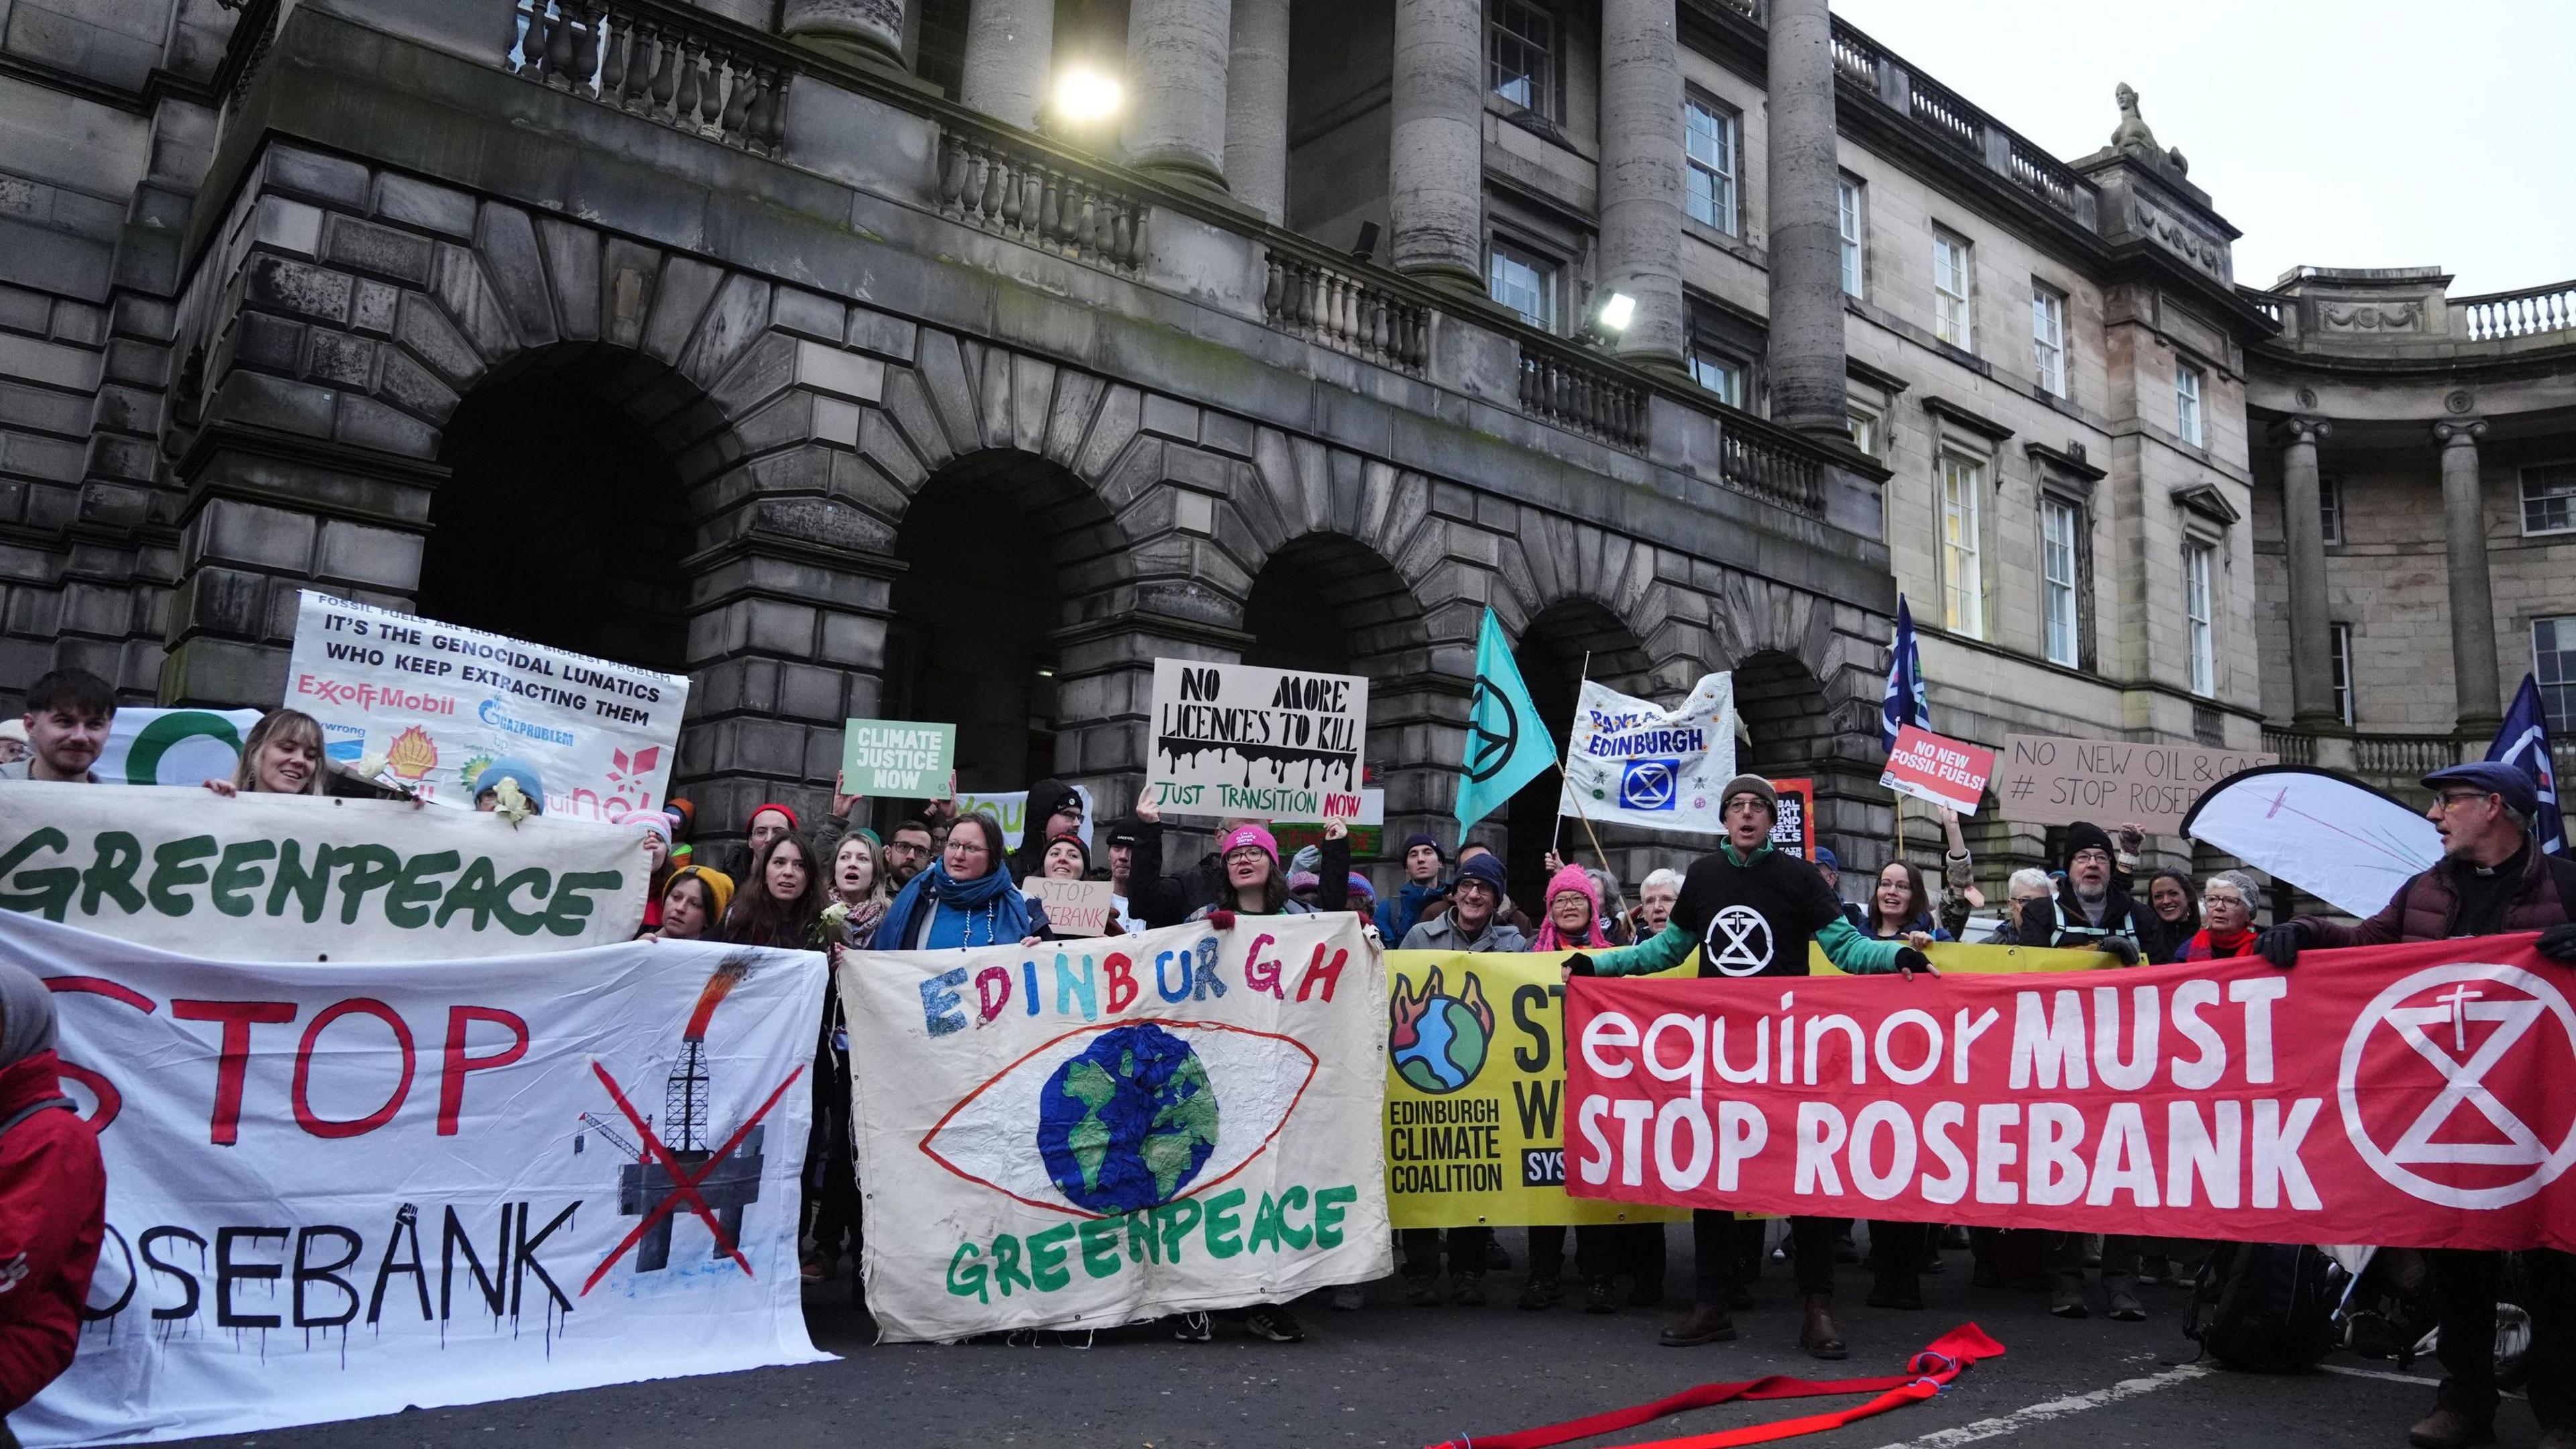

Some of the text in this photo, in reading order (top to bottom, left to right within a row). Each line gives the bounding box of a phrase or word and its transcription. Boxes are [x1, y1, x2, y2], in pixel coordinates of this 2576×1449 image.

[318, 595, 373, 613] FOSSIL
[381, 609, 427, 624] FUELS
[608, 659, 671, 683] PROBLEM
[325, 614, 660, 703] IT'S THE GENOCIDAL LUNATICS
[326, 641, 649, 727] WHO KEEP EXTRACTING THEM
[1181, 667, 1350, 712] NO MORE
[857, 727, 943, 751] CLIMATE
[1163, 703, 1357, 751] LICENCES TO KILL
[1588, 729, 1703, 757] EDINBURGH
[857, 747, 938, 771] JUSTICE
[1890, 749, 1936, 775] FOSSIL
[1937, 765, 1986, 791] FUELS!
[1914, 741, 1970, 769] NO NEW
[2015, 741, 2055, 765] NO
[2077, 745, 2131, 775] NEW
[873, 769, 920, 790] NOW
[2050, 777, 2116, 808] STOP
[1155, 782, 1205, 805] JUST
[1324, 792, 1361, 817] NOW
[0, 826, 623, 937] GREENPEACE
[1040, 881, 1093, 903] STOP
[919, 933, 1348, 1038] EDINBURGH
[1581, 976, 2286, 1098] equinor MUST
[1390, 1099, 1499, 1126] EDINBURGH
[1391, 1126, 1501, 1161] CLIMATE
[1578, 1094, 2323, 1211] STOP ROSEBANK
[1391, 1163, 1503, 1193] COALITION
[946, 1185, 1357, 1304] GREENPEACE
